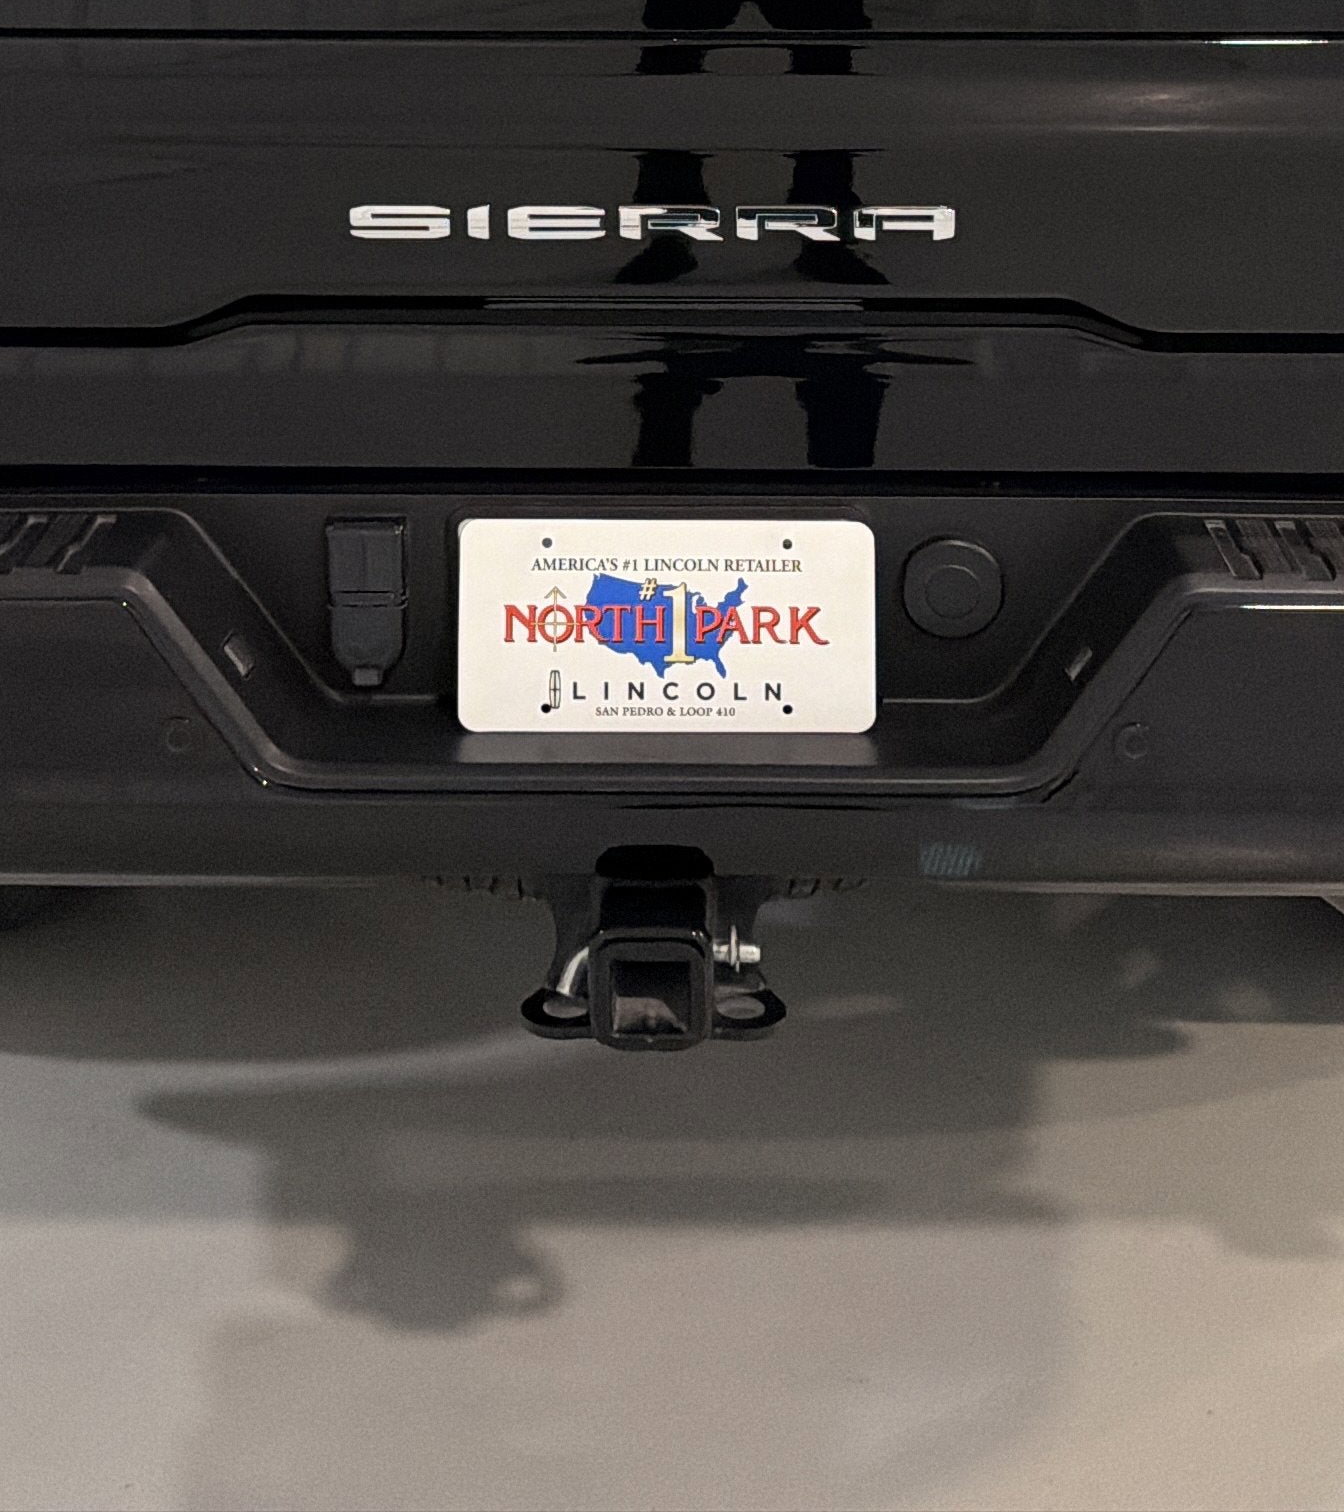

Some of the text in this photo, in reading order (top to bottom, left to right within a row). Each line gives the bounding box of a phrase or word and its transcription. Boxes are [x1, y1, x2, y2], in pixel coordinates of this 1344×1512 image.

[349, 204, 956, 242] SIERRA
[531, 557, 803, 573] AMERICA'S #1 LINCOLN RETAILER
[503, 603, 831, 646] NORTH PARK
[572, 681, 782, 702] LINCOLN
[595, 706, 736, 717] SAN PEDRO & LOOP 410
